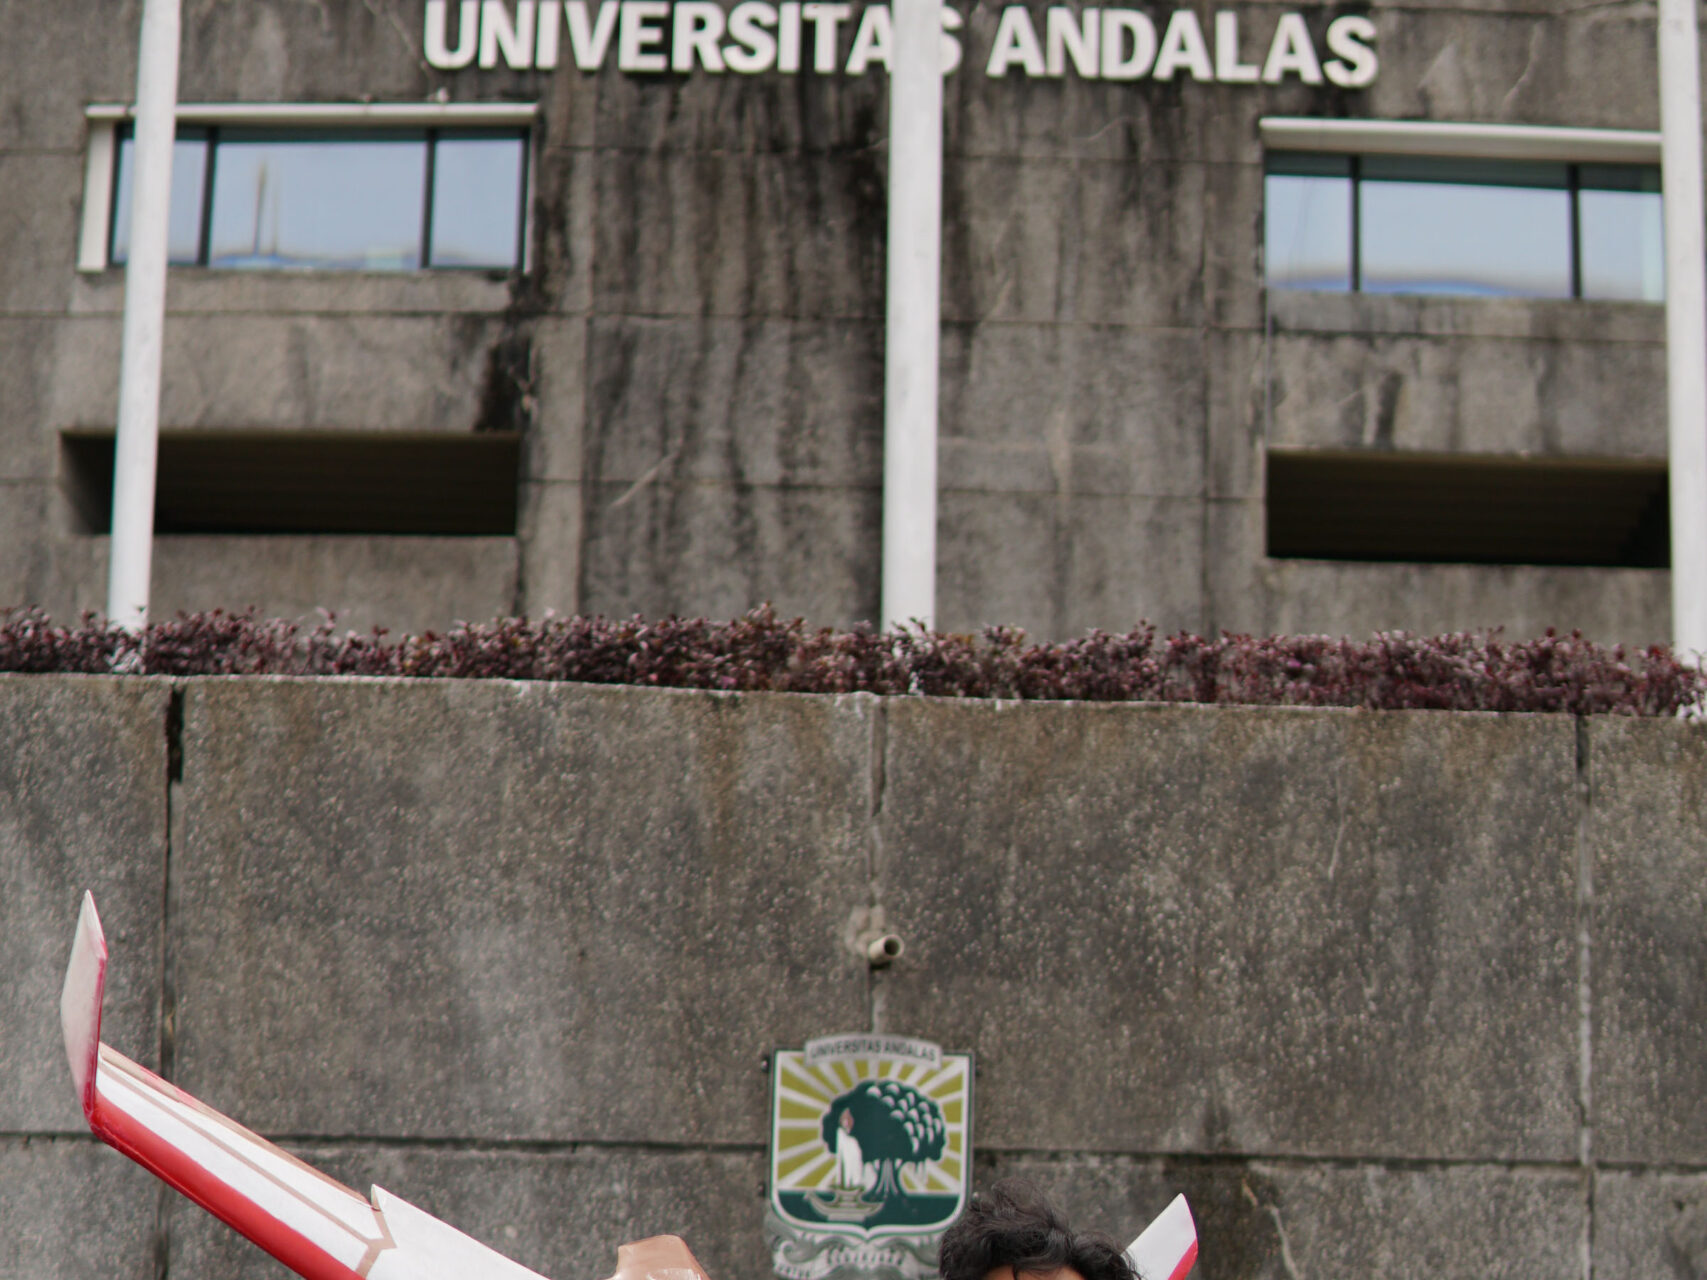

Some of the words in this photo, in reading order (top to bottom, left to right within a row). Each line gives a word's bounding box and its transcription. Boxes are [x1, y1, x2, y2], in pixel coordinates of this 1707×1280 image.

[986, 7, 1378, 87] ANDALAS
[811, 1039, 881, 1059] UNIVERSITAS
[883, 1039, 937, 1062] ANDALAS
